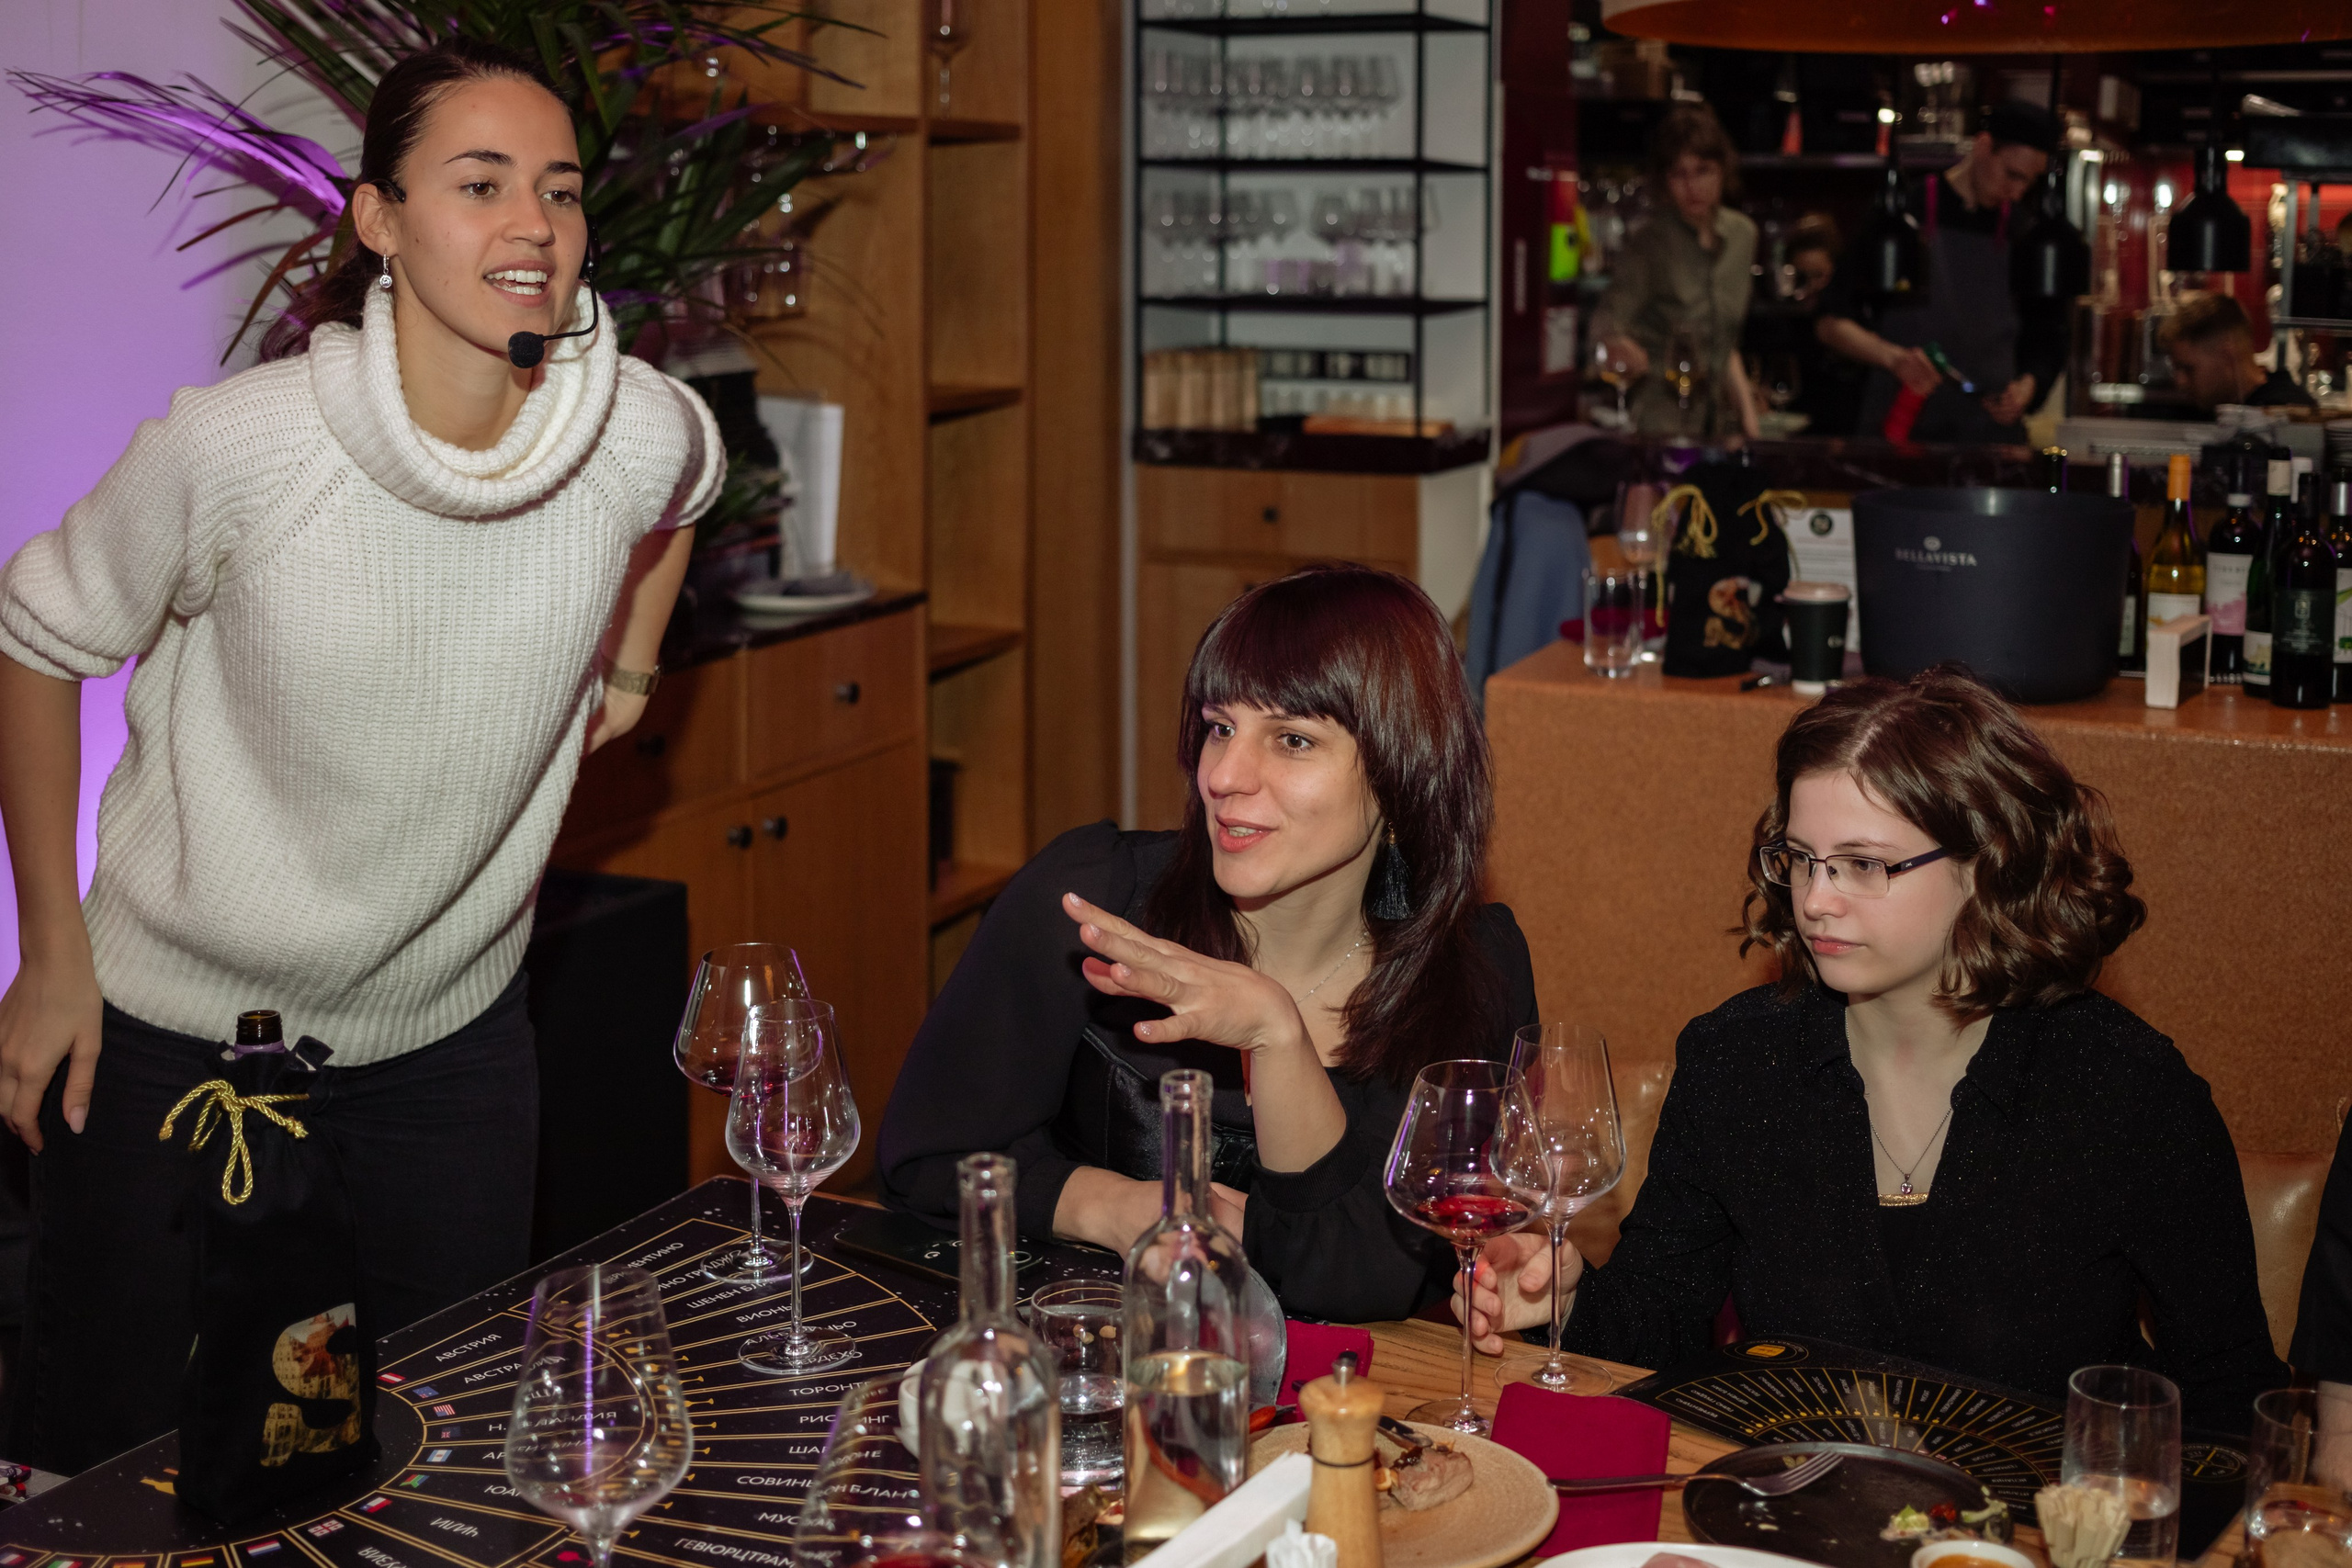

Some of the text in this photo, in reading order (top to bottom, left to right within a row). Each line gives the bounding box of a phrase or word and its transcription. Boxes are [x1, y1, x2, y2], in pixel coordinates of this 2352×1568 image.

[1894, 547, 1978, 567] BELLAVISTA
[686, 1289, 741, 1309] ШЕНЕН
[736, 1302, 797, 1323] ВИОНЬ
[435, 1333, 502, 1363] АВСТРИЯ
[799, 1414, 890, 1425] РИСИНГ
[429, 1517, 480, 1538] ЧИЛИ
